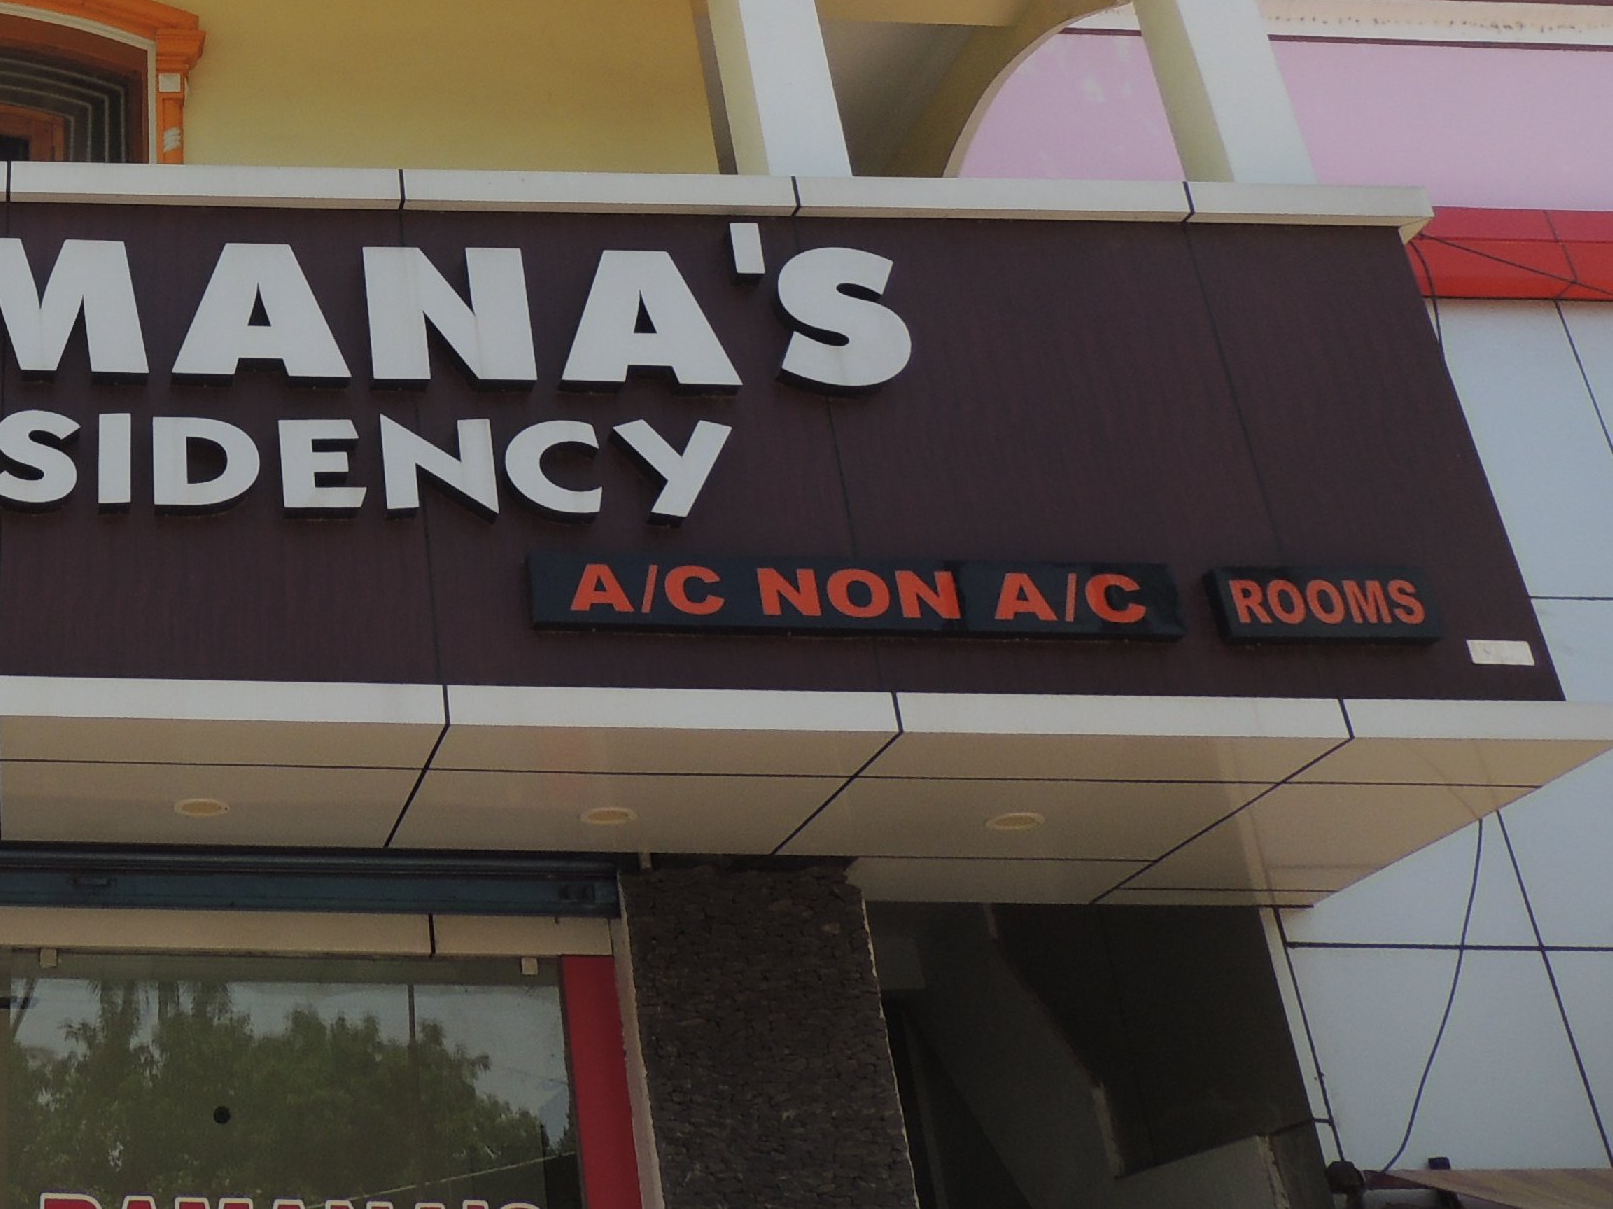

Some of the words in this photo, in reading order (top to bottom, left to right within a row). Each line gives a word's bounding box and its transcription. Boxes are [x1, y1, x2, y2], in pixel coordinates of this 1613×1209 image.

[570, 564, 726, 616] A/C
[757, 567, 962, 620] NON
[994, 573, 1147, 624] A/C
[1229, 579, 1426, 625] ROOMS
